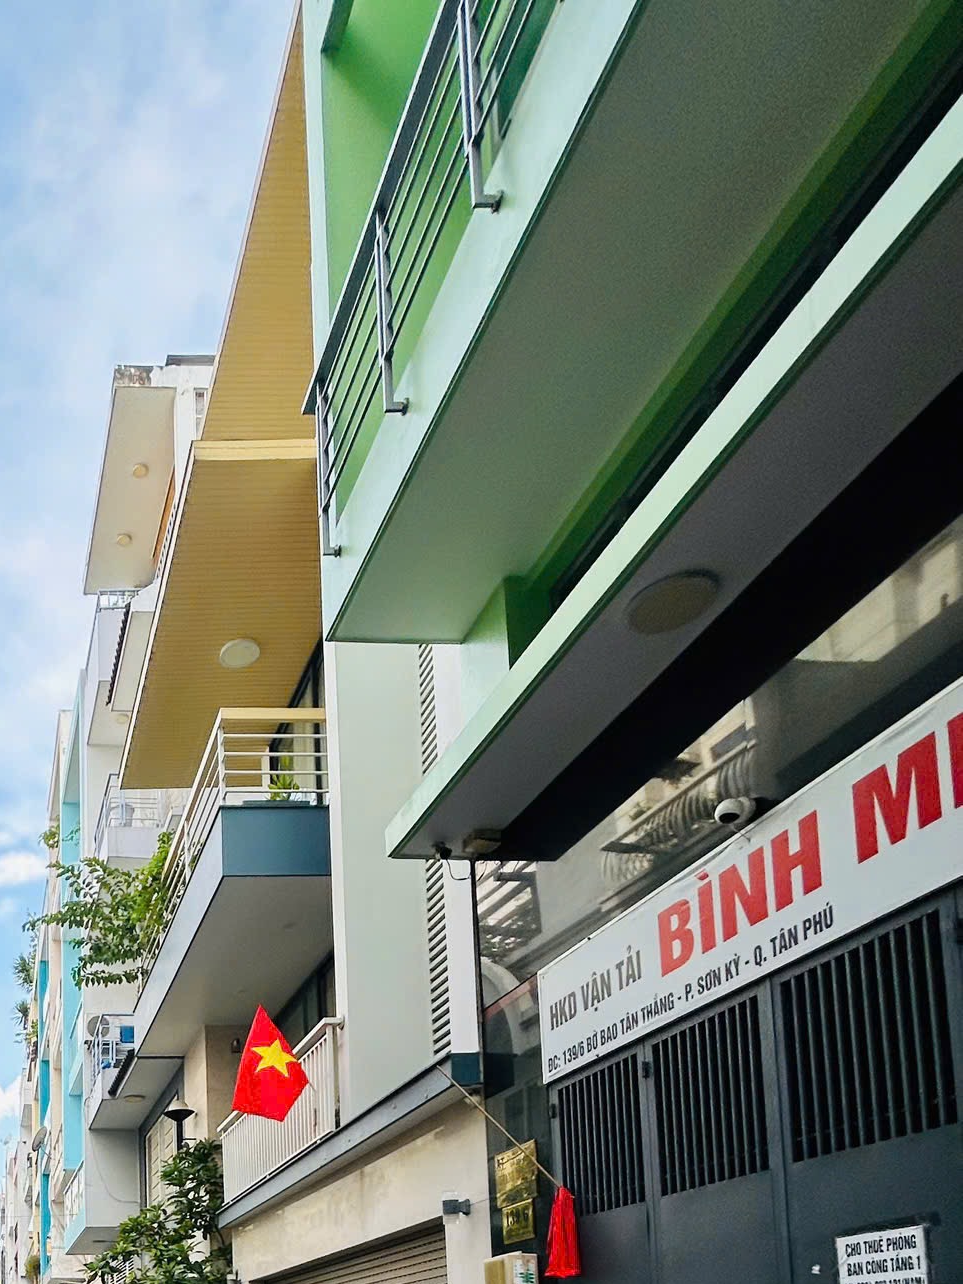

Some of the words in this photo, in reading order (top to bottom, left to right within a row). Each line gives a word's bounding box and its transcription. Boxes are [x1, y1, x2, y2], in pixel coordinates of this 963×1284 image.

[657, 810, 823, 978] BÌNH
[548, 1055, 561, 1073] ĐC:
[563, 1041, 585, 1065] 139/6
[600, 1023, 618, 1046] BAO
[620, 1012, 638, 1035] TÂN
[685, 982, 695, 1001] P.
[697, 965, 721, 995] SƠN
[754, 945, 767, 967] Q.
[770, 928, 799, 958] TÂN
[803, 902, 834, 940] PHÚ
[550, 991, 577, 1031] HKD
[581, 971, 612, 1012] VẬN
[616, 945, 642, 991] TẢI
[845, 1242, 861, 1257] CHO
[863, 1235, 885, 1254] THUÊ
[886, 1232, 917, 1251] PHÒNG
[847, 1262, 864, 1276] BAN
[865, 1257, 888, 1274] CÔNG
[916, 1255, 921, 1270] 1
